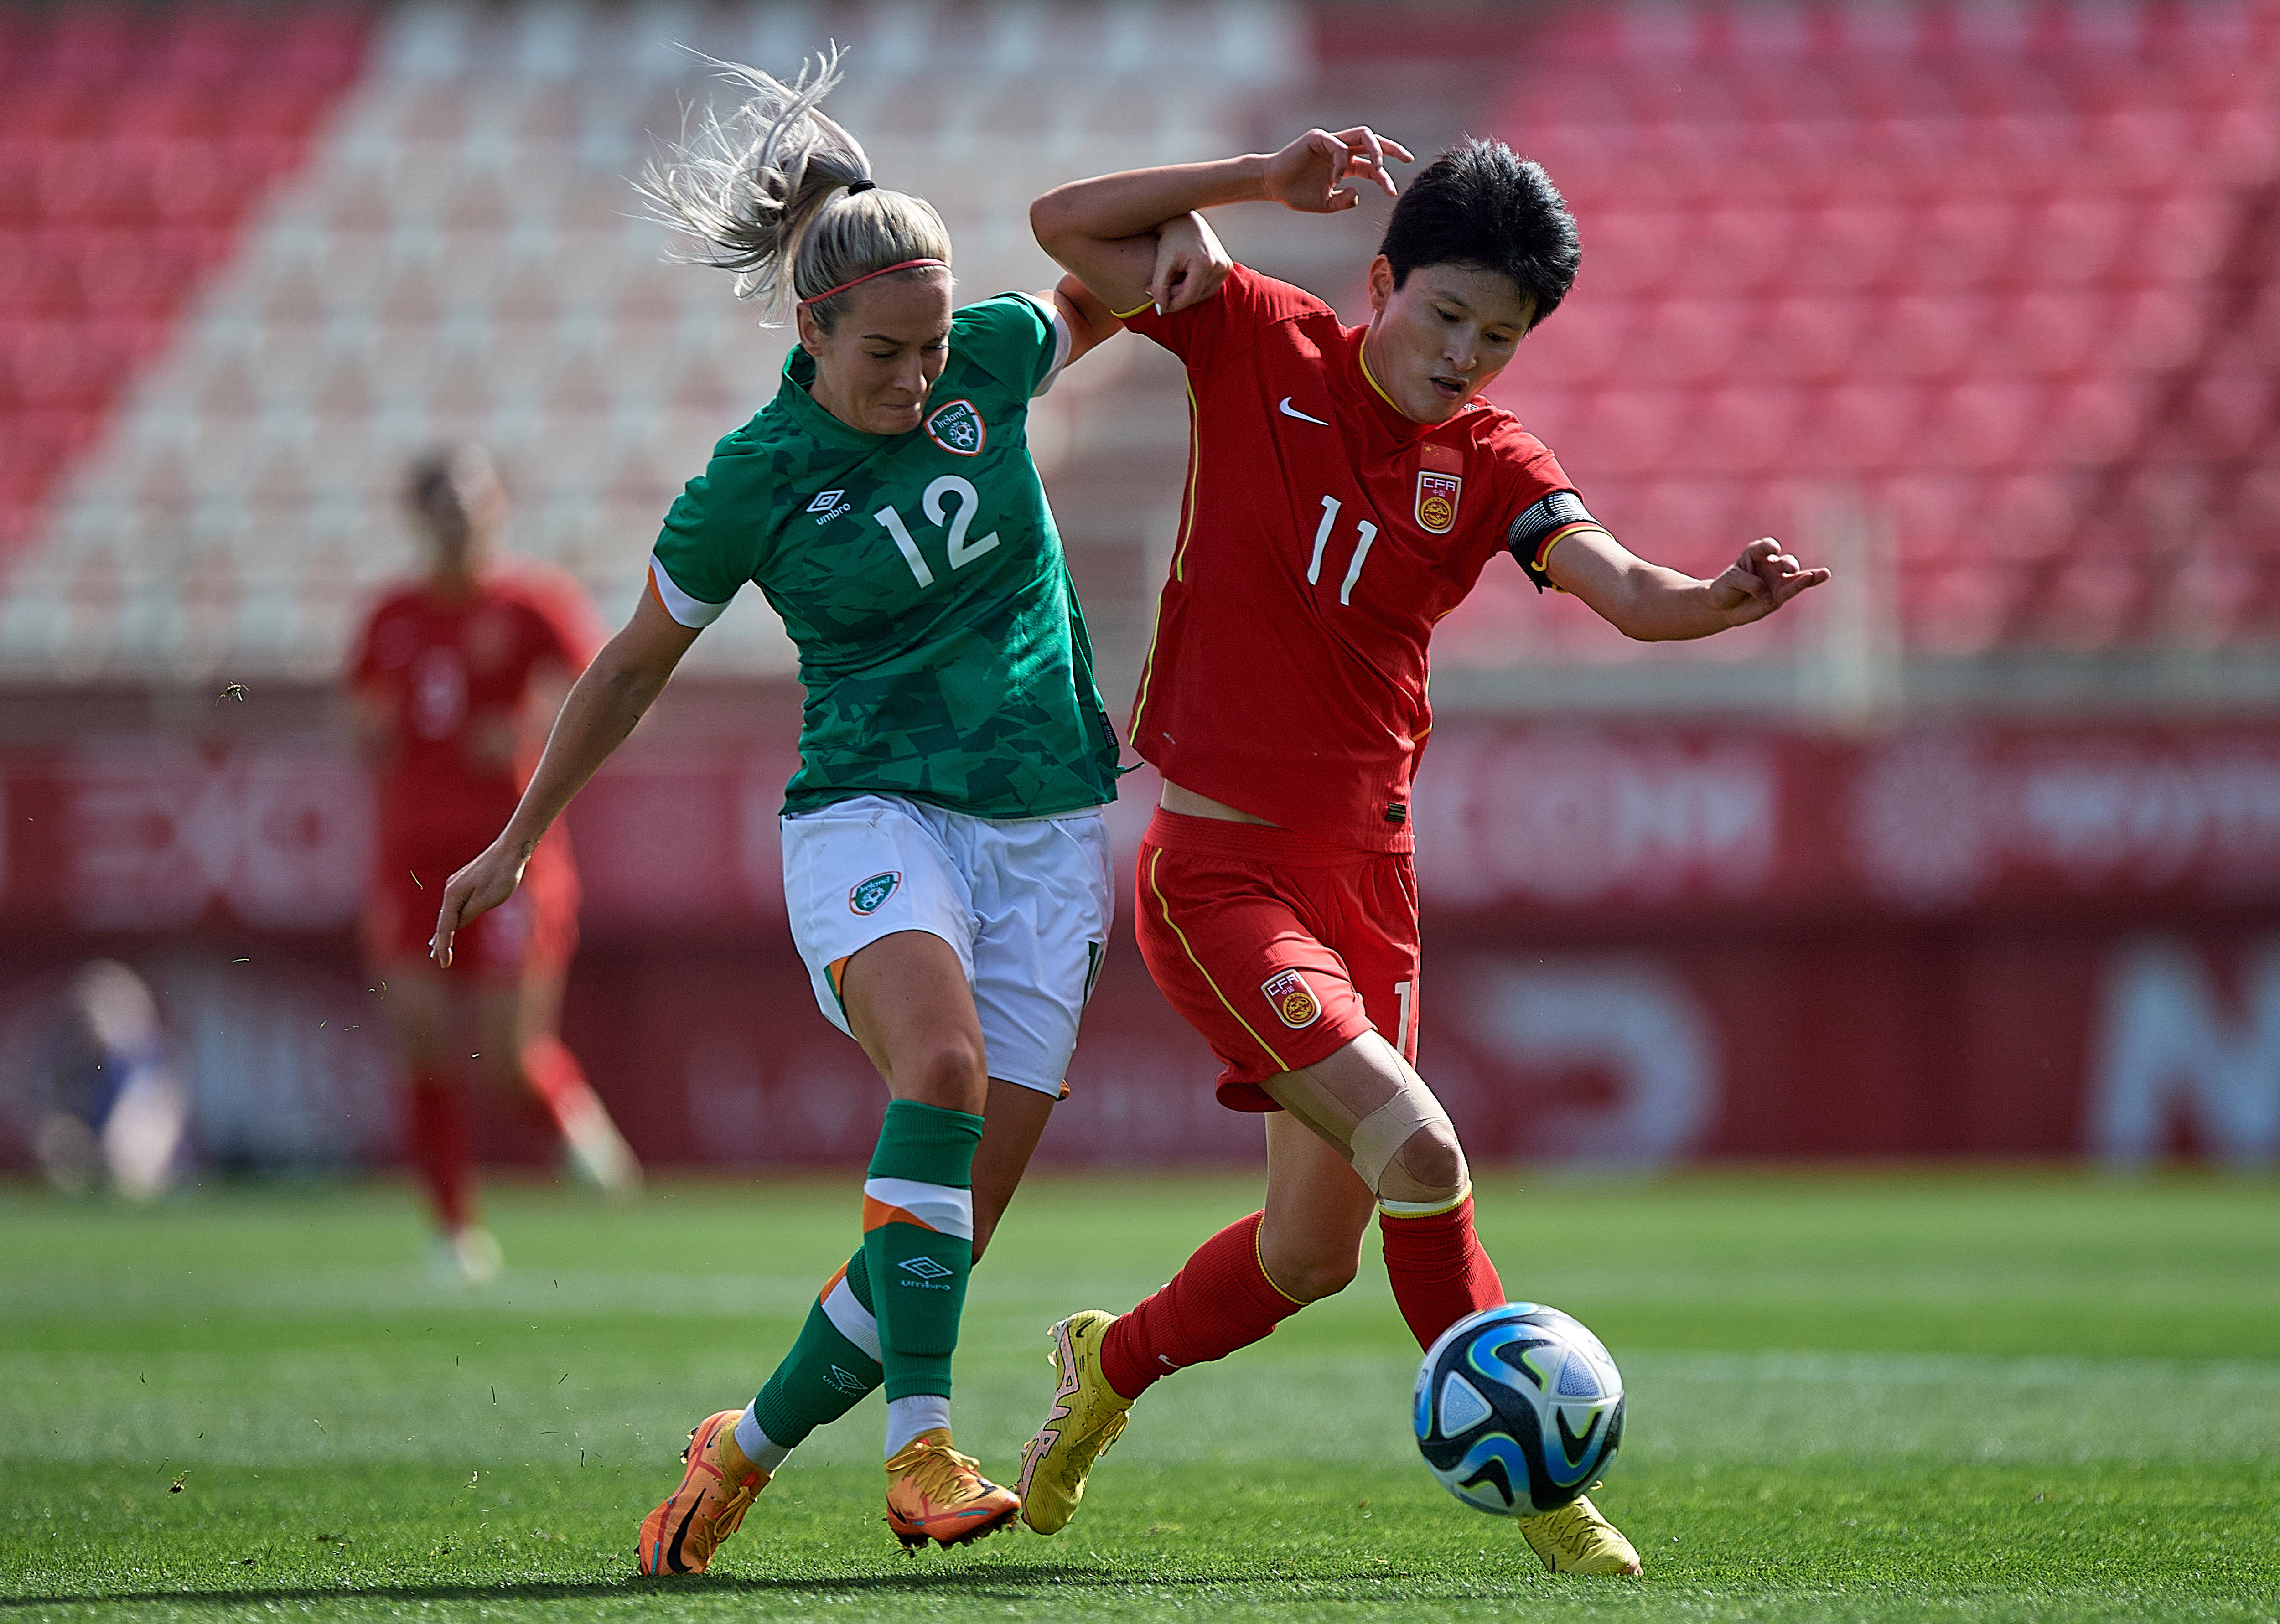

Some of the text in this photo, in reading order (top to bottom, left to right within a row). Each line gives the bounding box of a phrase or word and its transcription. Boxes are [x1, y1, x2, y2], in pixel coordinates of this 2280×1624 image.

[933, 405, 967, 429] Ireland
[1423, 477, 1456, 492] CFA
[816, 503, 851, 525] umbro
[873, 475, 1000, 589] 12
[1307, 495, 1378, 606] 11
[860, 876, 890, 894] Ireland
[1267, 973, 1299, 996] CFA
[901, 1280, 951, 1291] umbro
[822, 1375, 857, 1397] umbro
